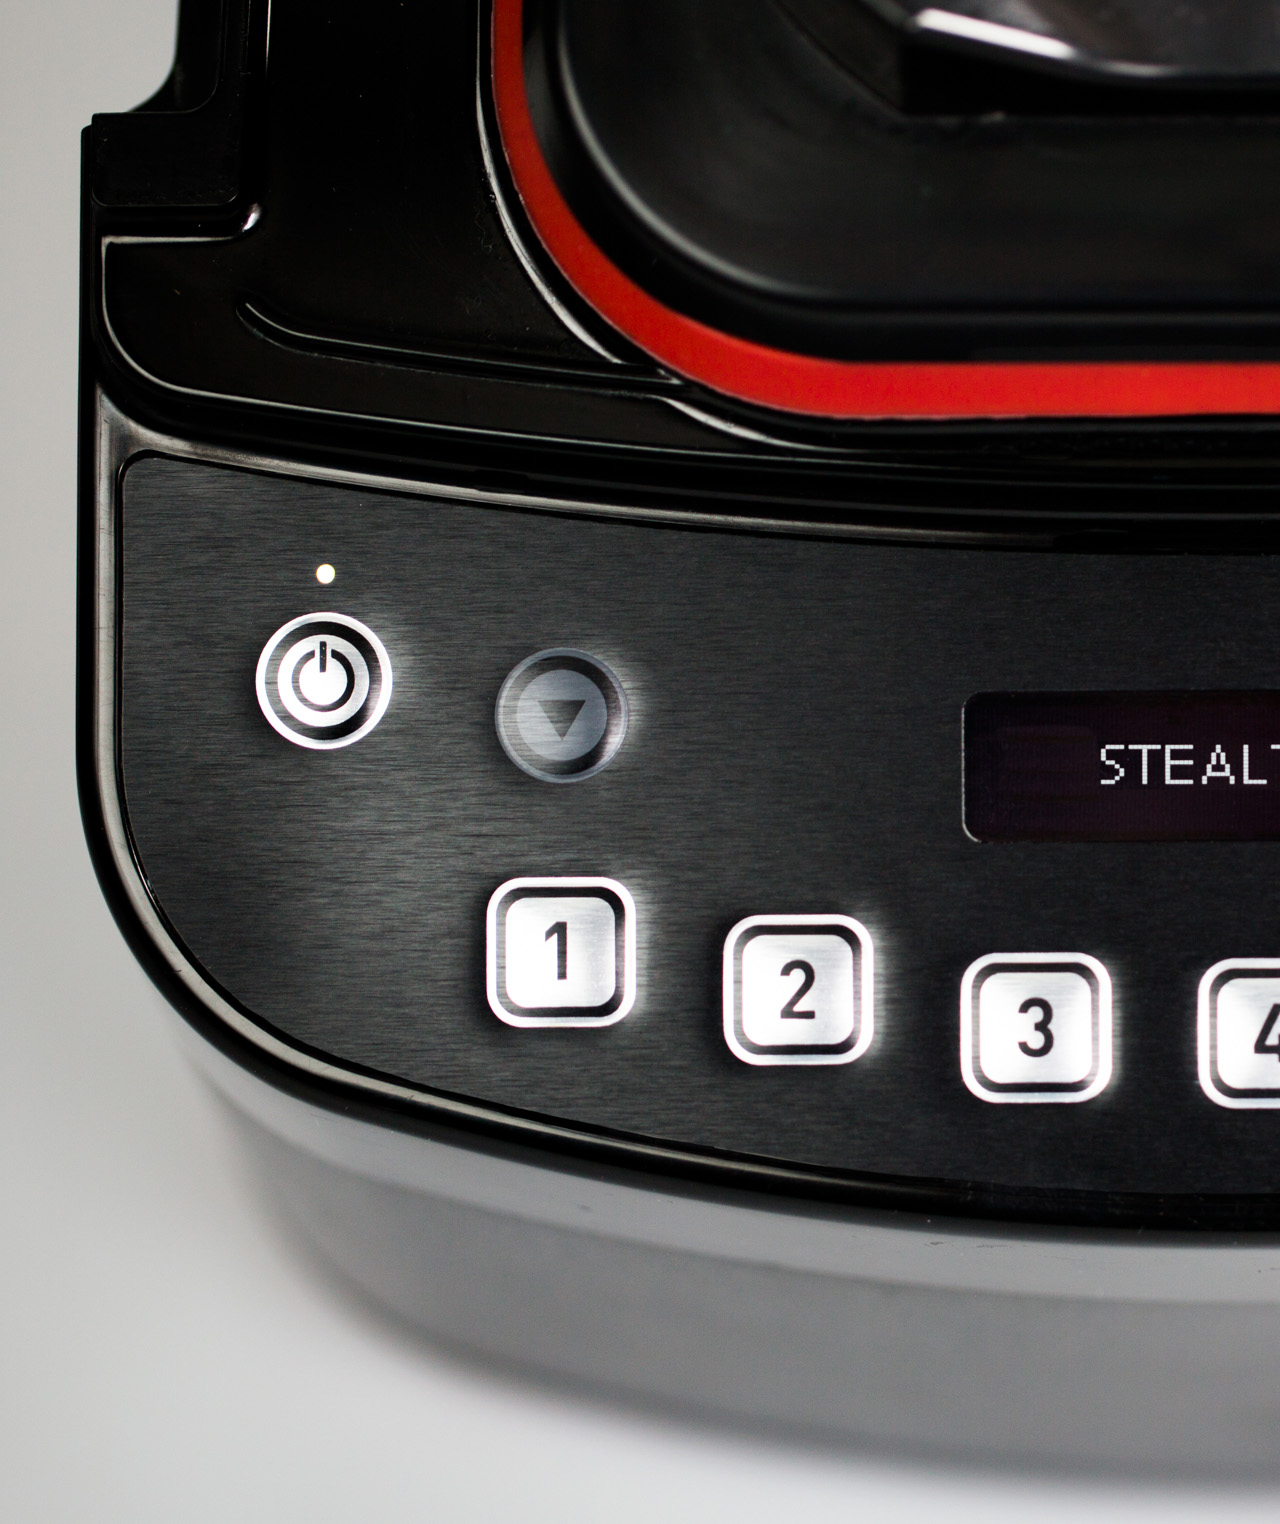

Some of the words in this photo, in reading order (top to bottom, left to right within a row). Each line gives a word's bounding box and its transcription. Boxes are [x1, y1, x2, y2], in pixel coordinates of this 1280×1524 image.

[544, 921, 569, 980] 1
[780, 960, 816, 1020] 2
[1018, 997, 1054, 1058] 3
